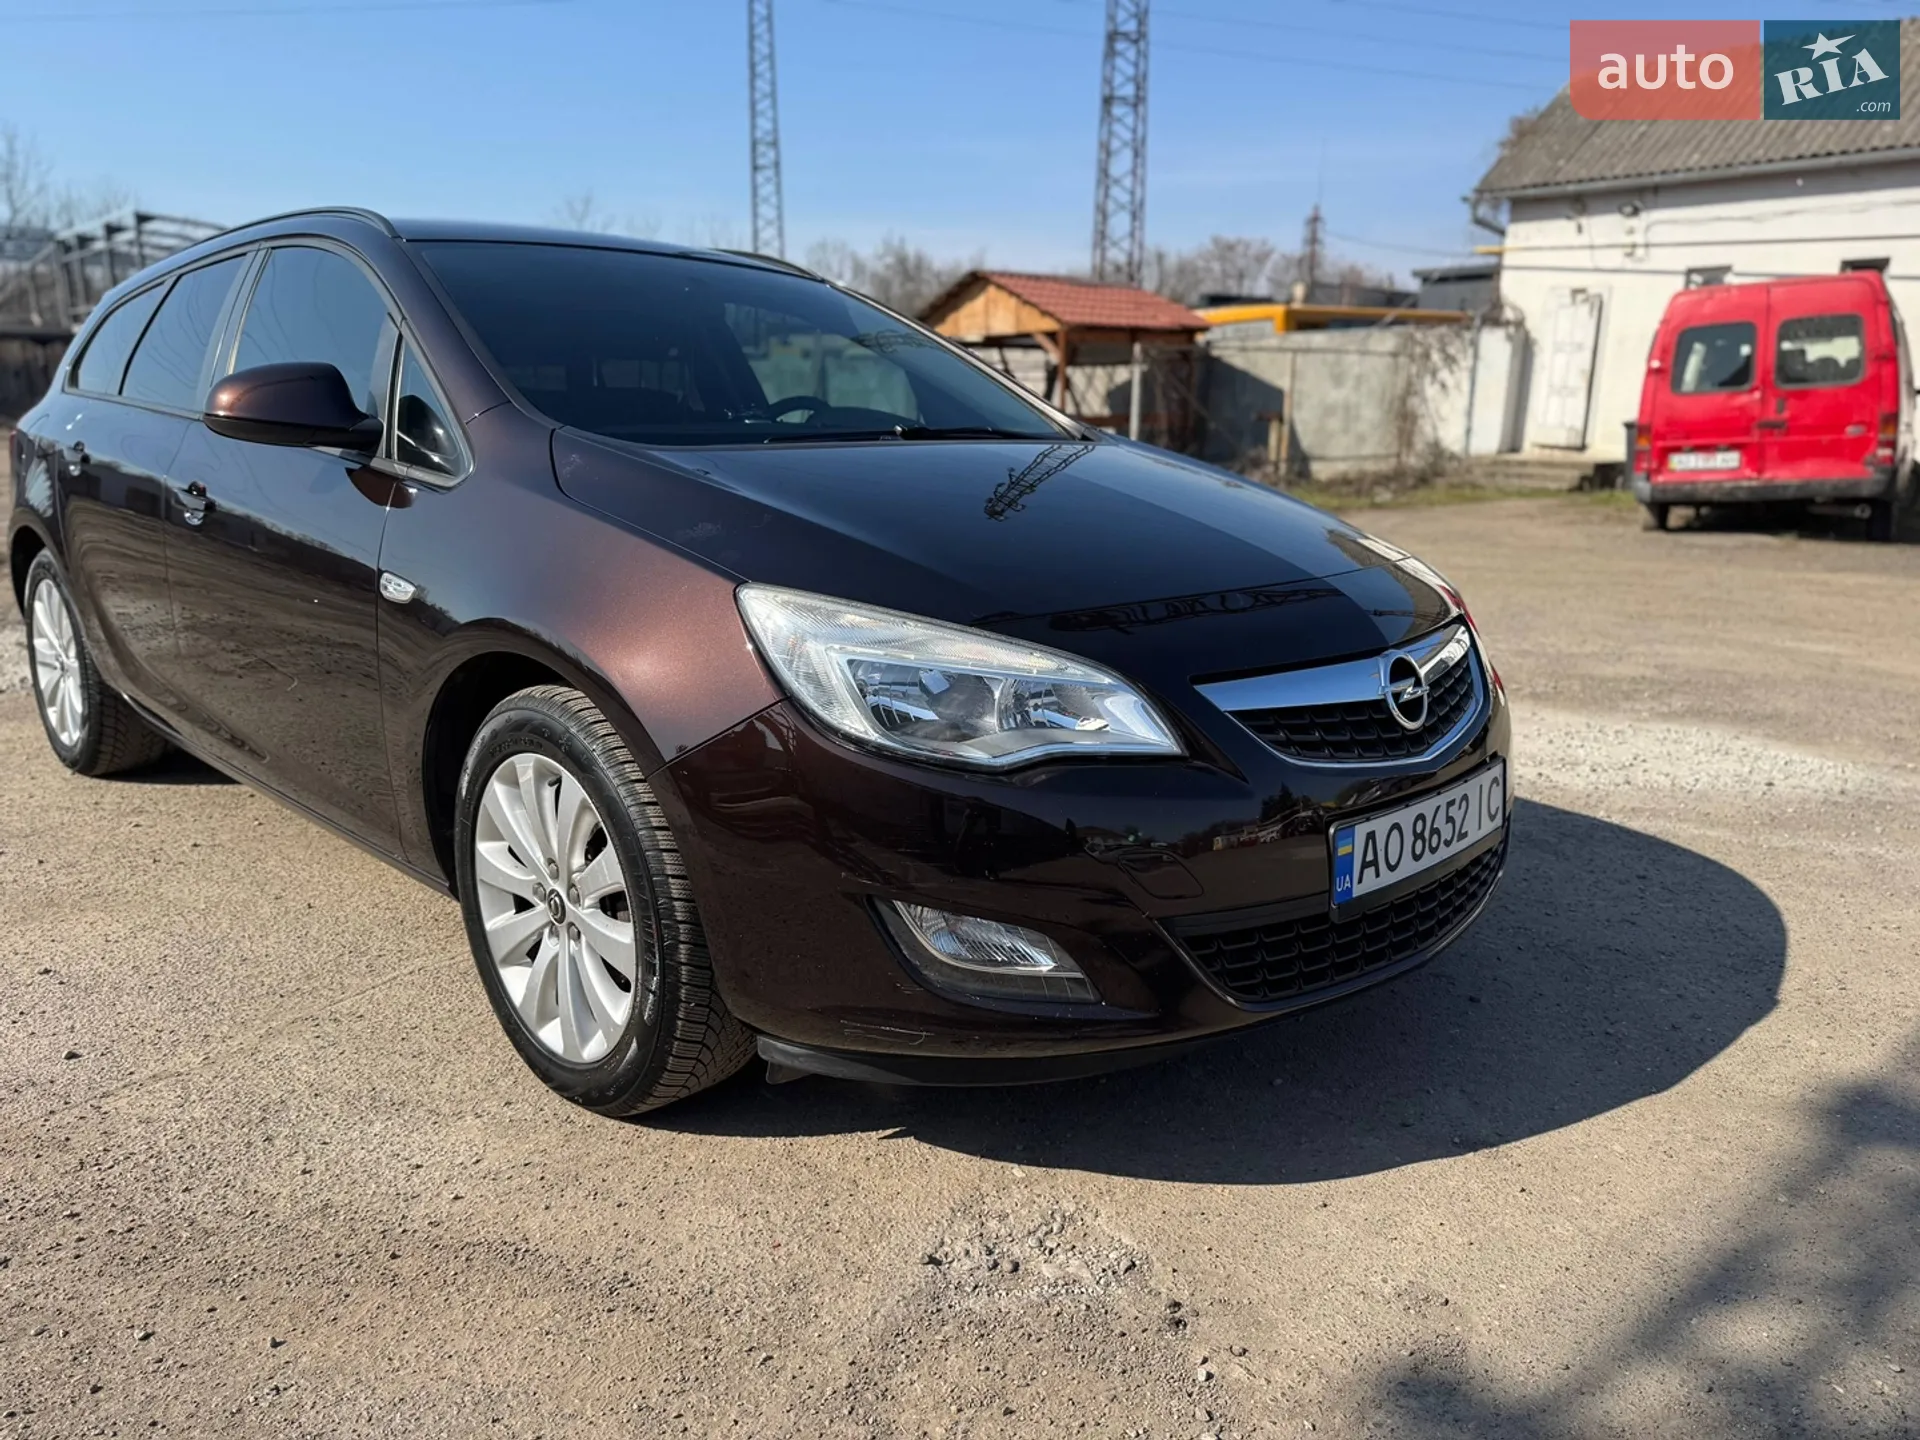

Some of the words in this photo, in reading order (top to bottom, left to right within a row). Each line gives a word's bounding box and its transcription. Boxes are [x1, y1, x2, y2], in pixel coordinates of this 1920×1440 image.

[1357, 822, 1404, 885] AO
[1411, 793, 1469, 862] 8652
[1478, 776, 1500, 831] IC
[1336, 875, 1352, 892] UA
